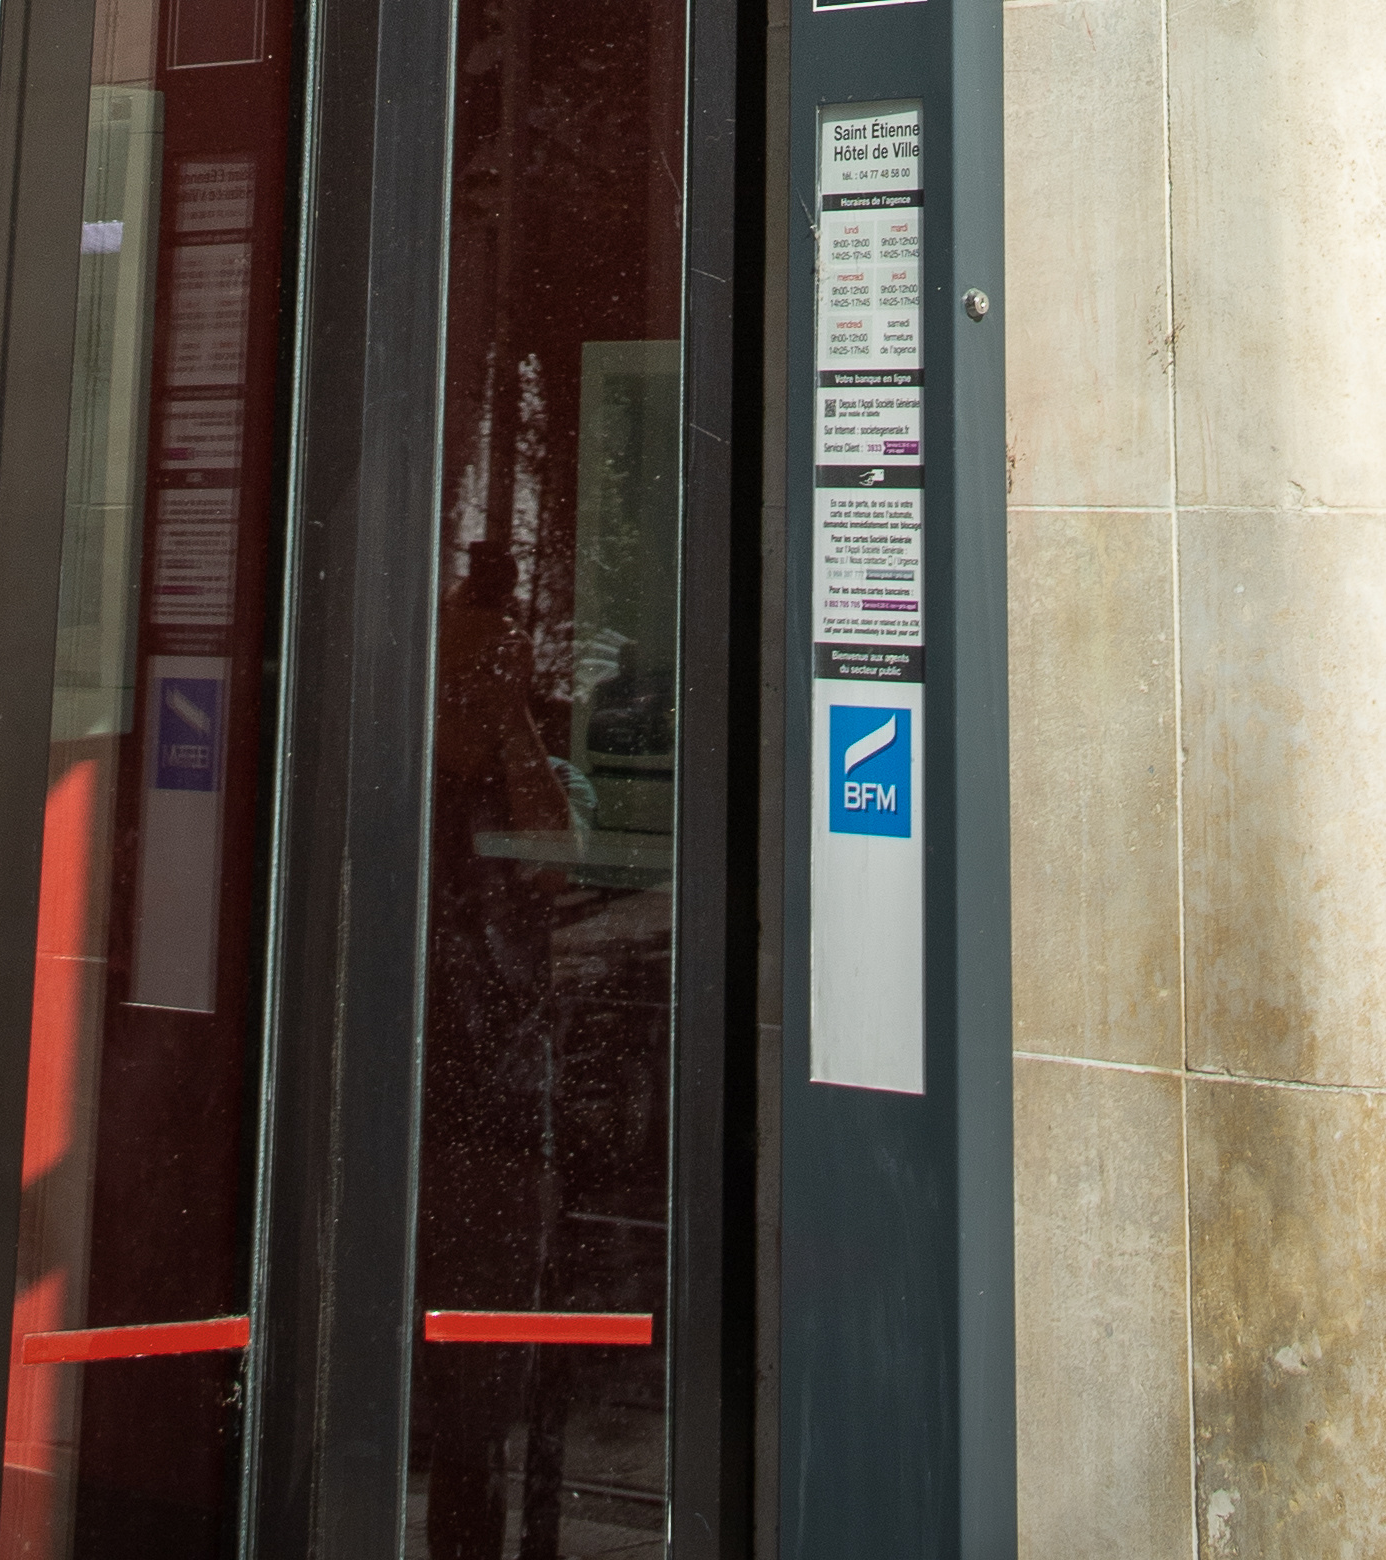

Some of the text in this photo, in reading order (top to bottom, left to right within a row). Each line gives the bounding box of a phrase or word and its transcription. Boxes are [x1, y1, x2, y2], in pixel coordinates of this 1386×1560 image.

[834, 119, 920, 141] Saint Étienne
[834, 142, 920, 161] Hôtel de Ville
[859, 171, 868, 179] 04
[870, 170, 878, 179] 77
[901, 168, 910, 177] 00
[841, 198, 870, 206] Horaires
[882, 196, 911, 206] l'agence
[835, 374, 911, 385] Votre banque en ligne
[844, 781, 897, 813] BFM
